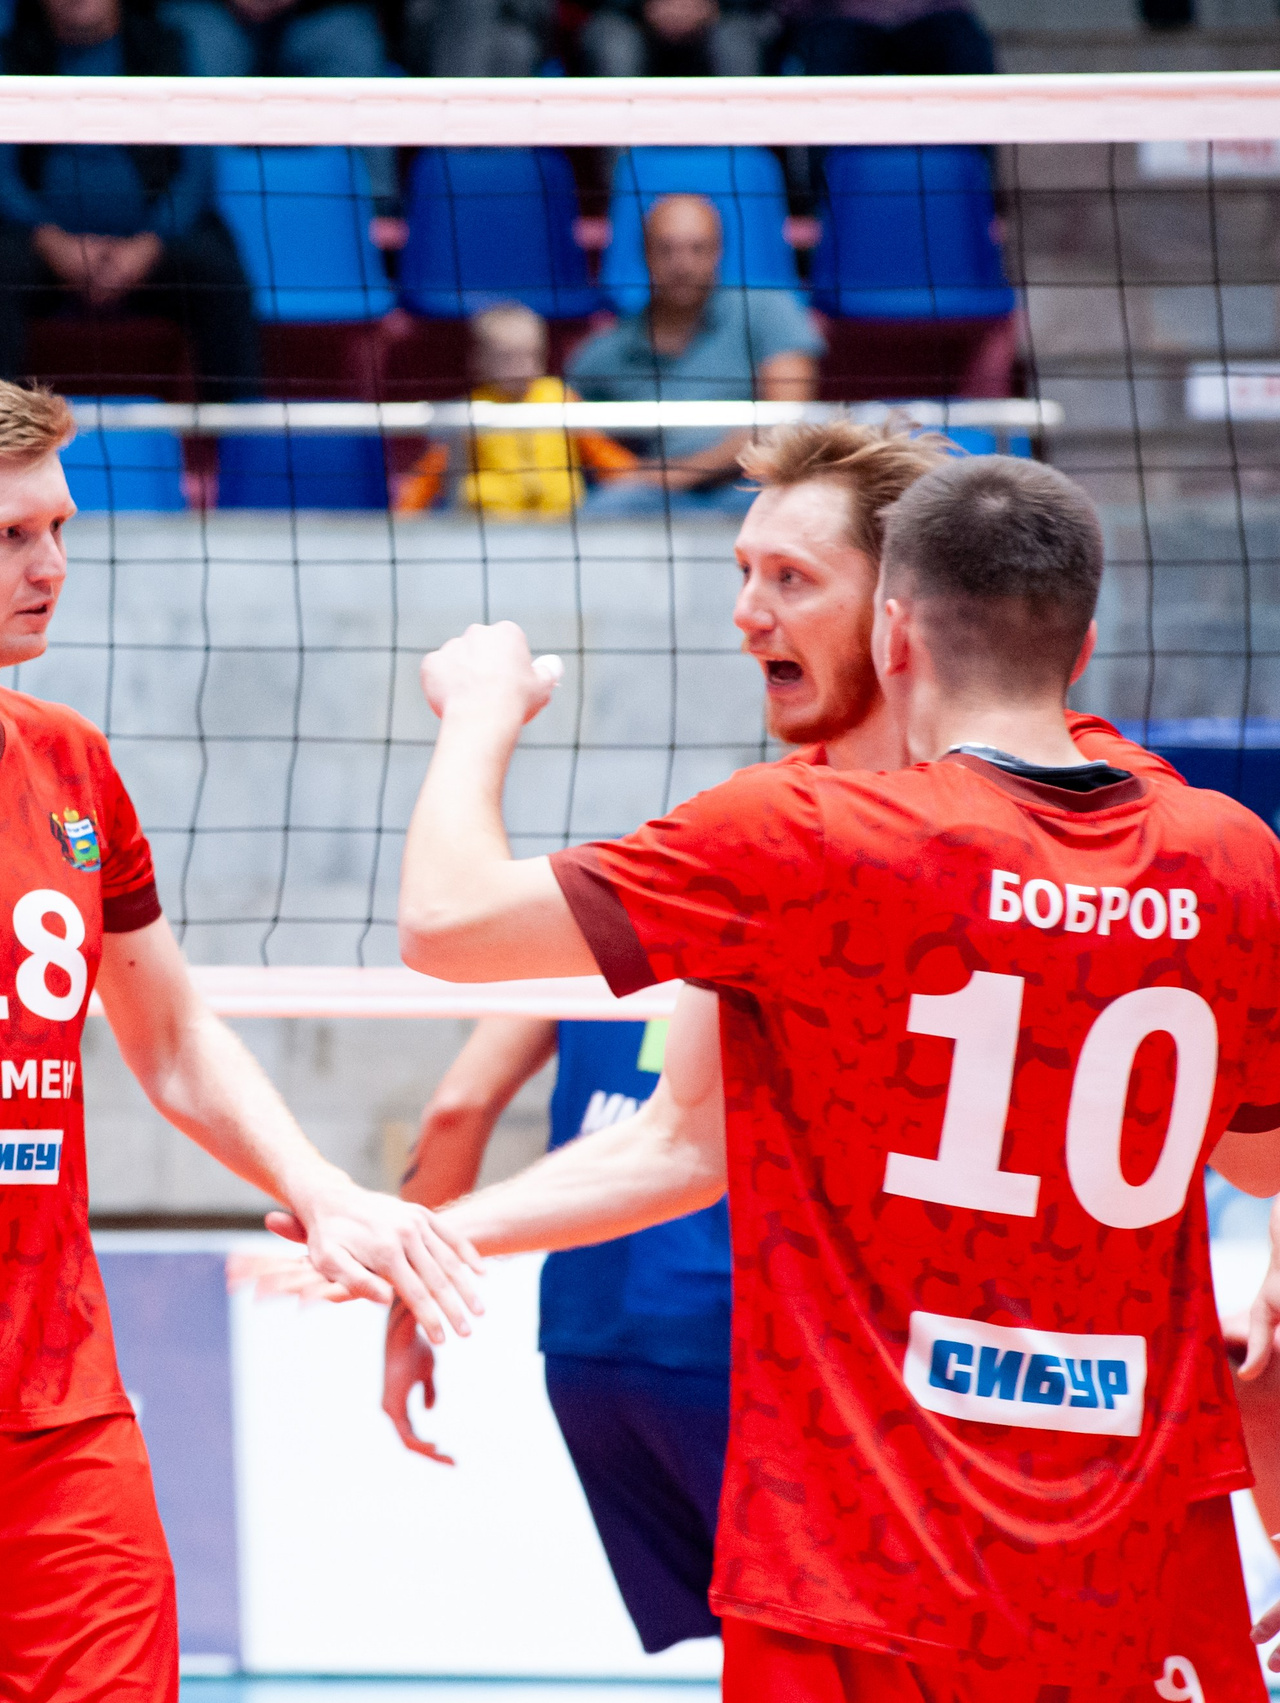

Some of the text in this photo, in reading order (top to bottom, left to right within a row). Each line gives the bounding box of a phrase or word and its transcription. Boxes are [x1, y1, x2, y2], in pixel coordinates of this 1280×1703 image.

[989, 869, 1201, 940] БОБРОВ
[883, 970, 1219, 1229] 10
[929, 1339, 1128, 1410] СИБУР
